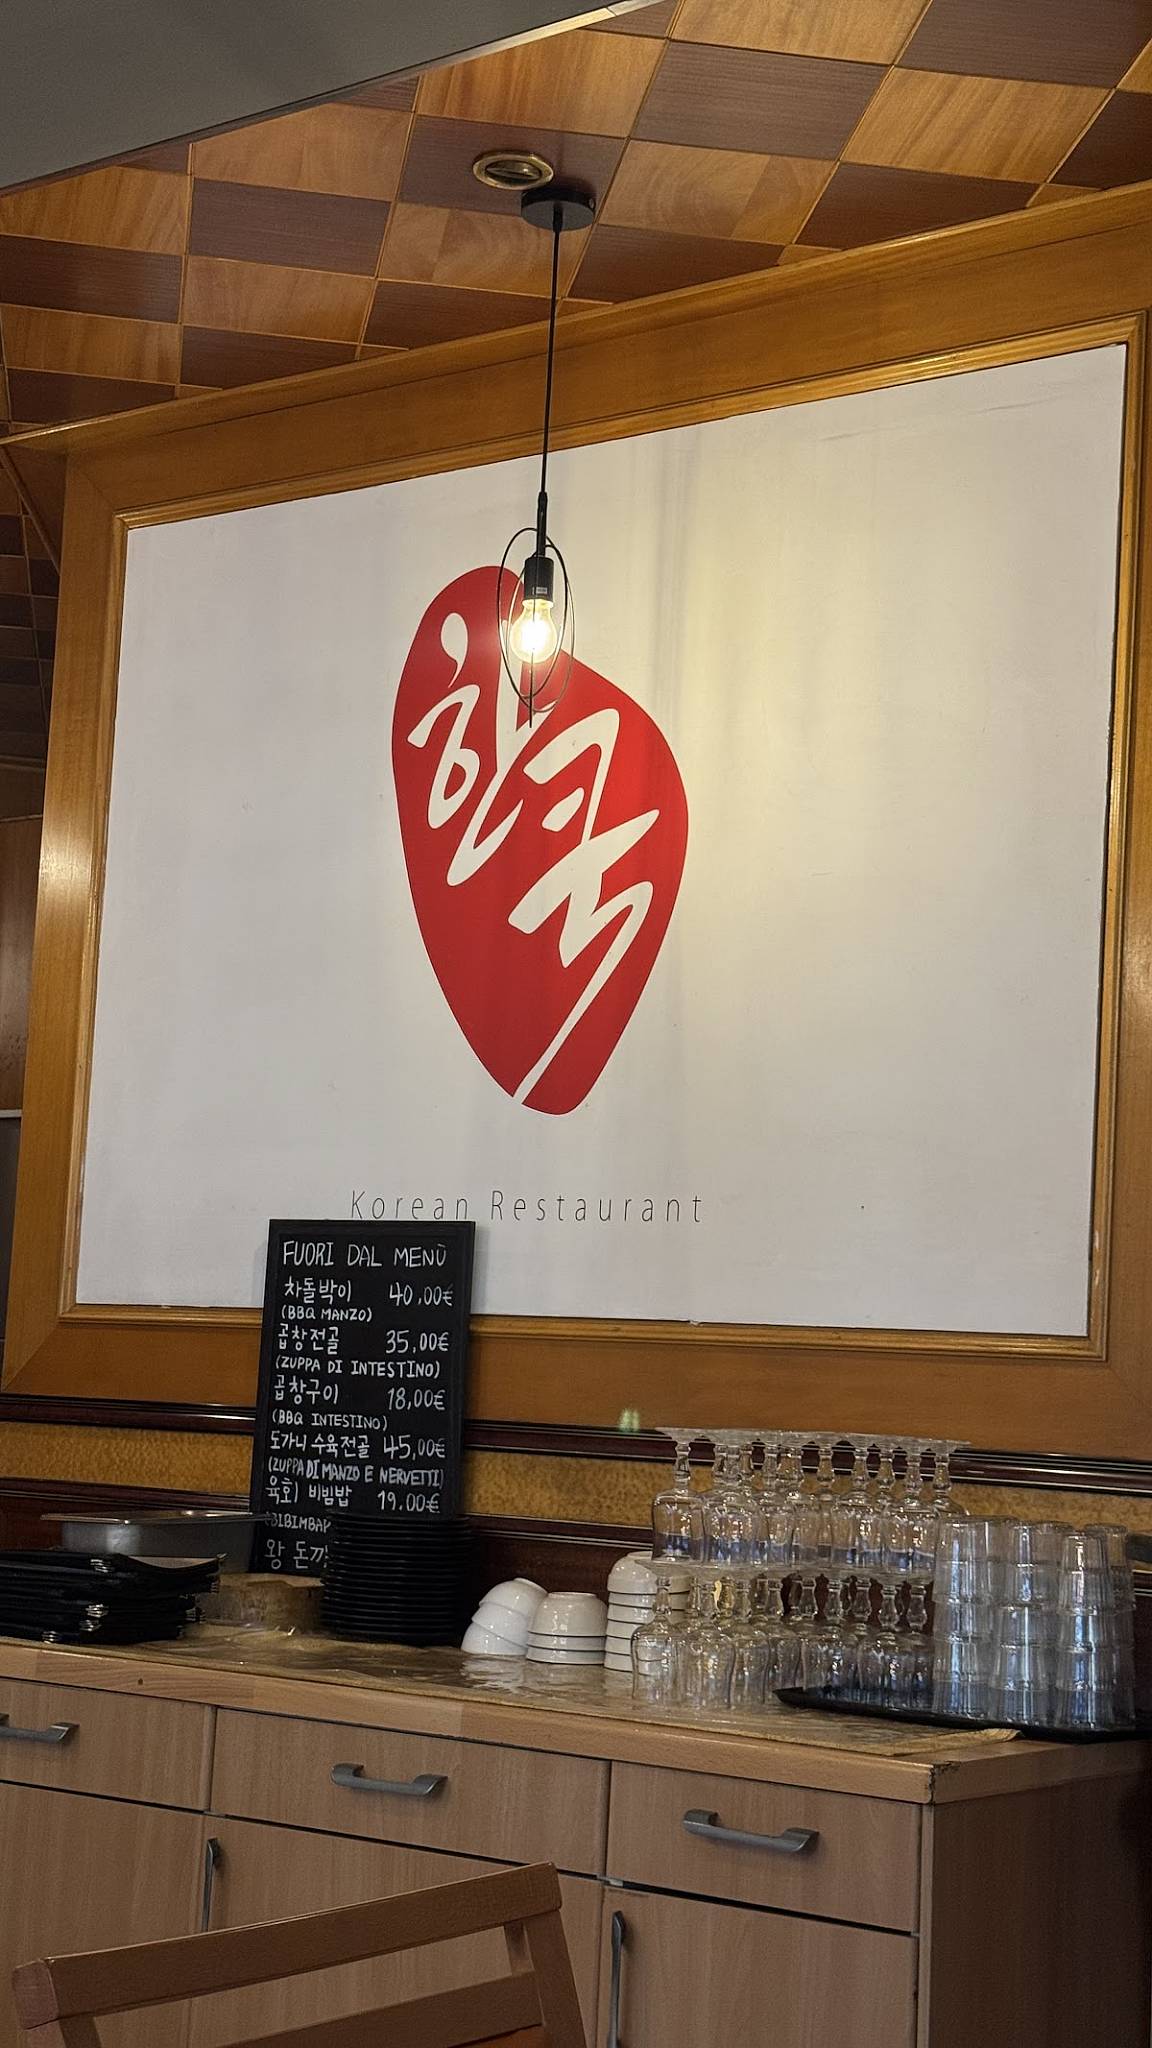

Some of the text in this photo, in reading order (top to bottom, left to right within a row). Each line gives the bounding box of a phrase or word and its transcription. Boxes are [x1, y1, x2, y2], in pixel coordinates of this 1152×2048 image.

[350, 1189, 702, 1223] Korean Restaurant
[283, 1240, 334, 1267] FUORI
[347, 1243, 382, 1268] DAL
[284, 1275, 352, 1305] 차돌박이
[281, 1304, 373, 1323] (BBQ MANZO)
[277, 1322, 450, 1356] 곱창전골 35,00€
[275, 1354, 441, 1379] (ZUPPA DI INTESTINO)
[273, 1374, 447, 1411] 곱창구이 18,00€
[272, 1408, 388, 1431] (BBQ INTESTINO)
[383, 1434, 446, 1461] 45,00€
[268, 1456, 445, 1490] (ZUPPA DI MANZO E NERVETTI)
[308, 1483, 353, 1507] 비빔밥
[264, 1538, 286, 1570] 왕
